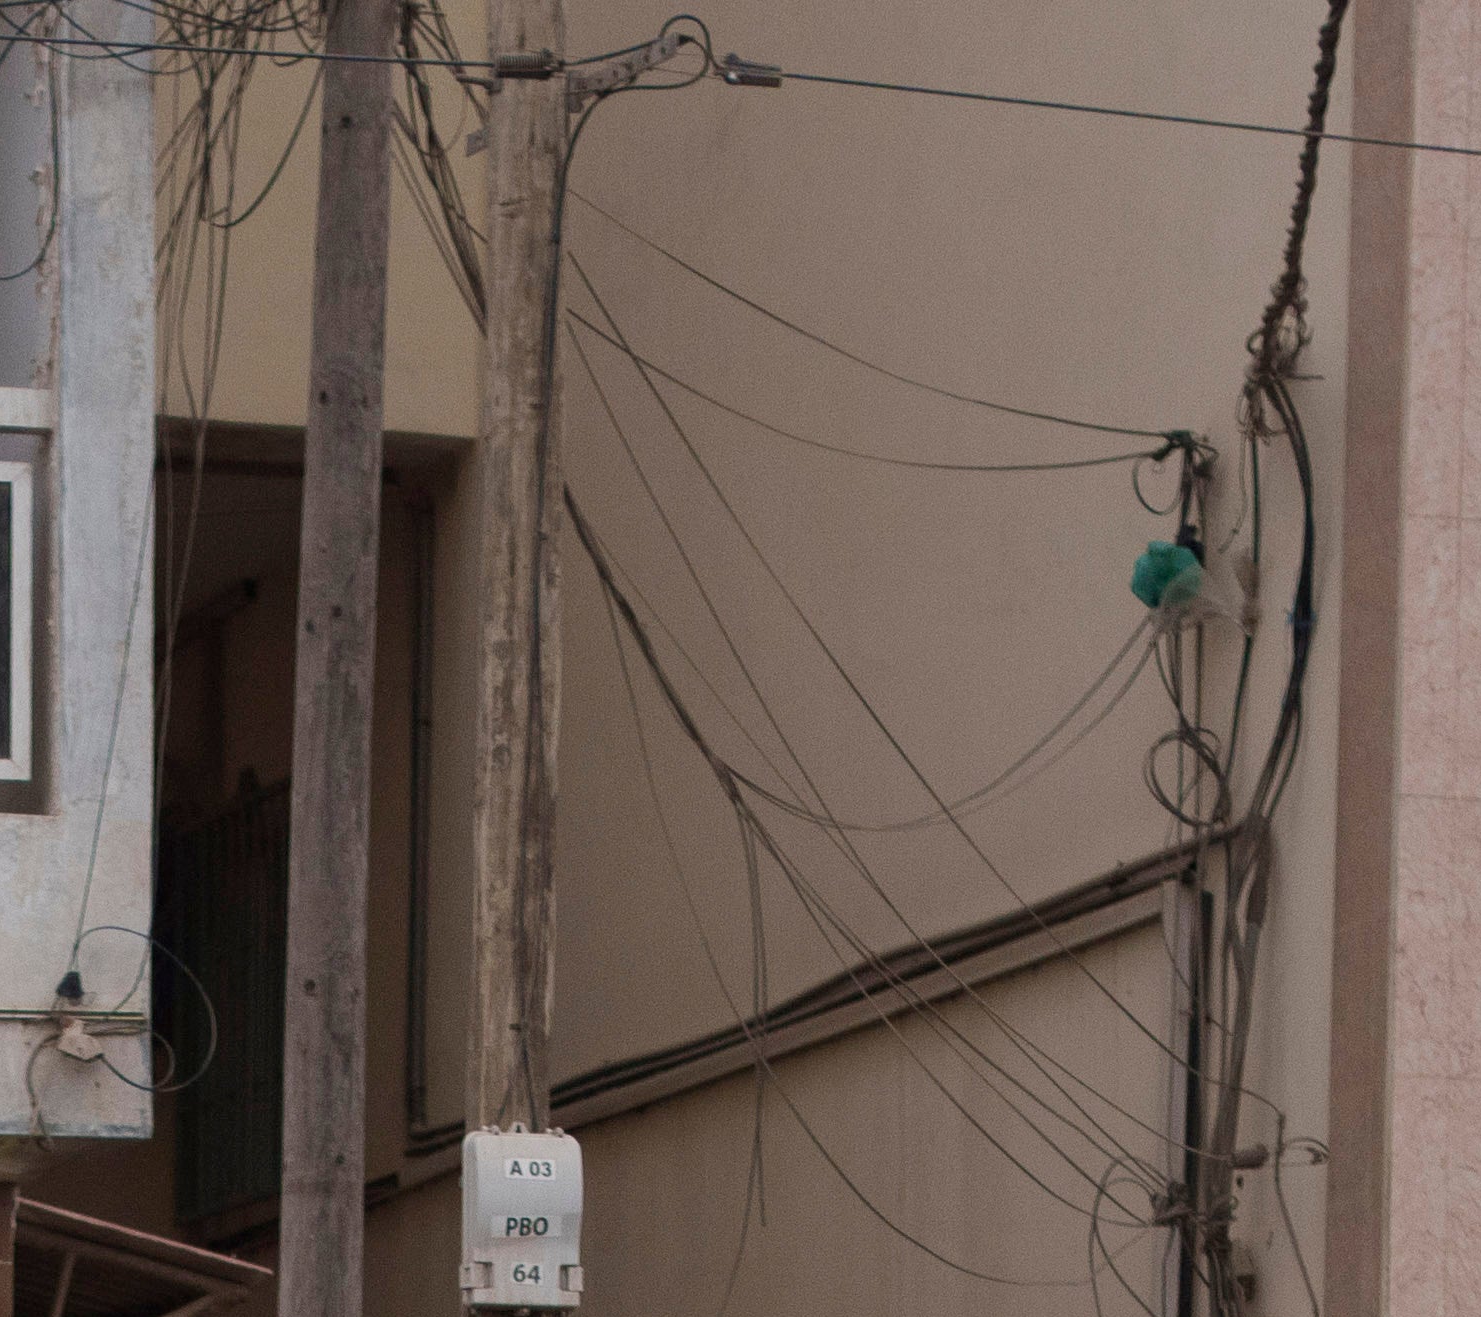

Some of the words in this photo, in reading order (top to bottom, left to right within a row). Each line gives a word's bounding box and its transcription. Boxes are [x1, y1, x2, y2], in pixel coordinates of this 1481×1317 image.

[509, 1160, 523, 1176] A
[529, 1161, 552, 1177] 03
[505, 1217, 549, 1237] PBO
[512, 1263, 541, 1284] 64
